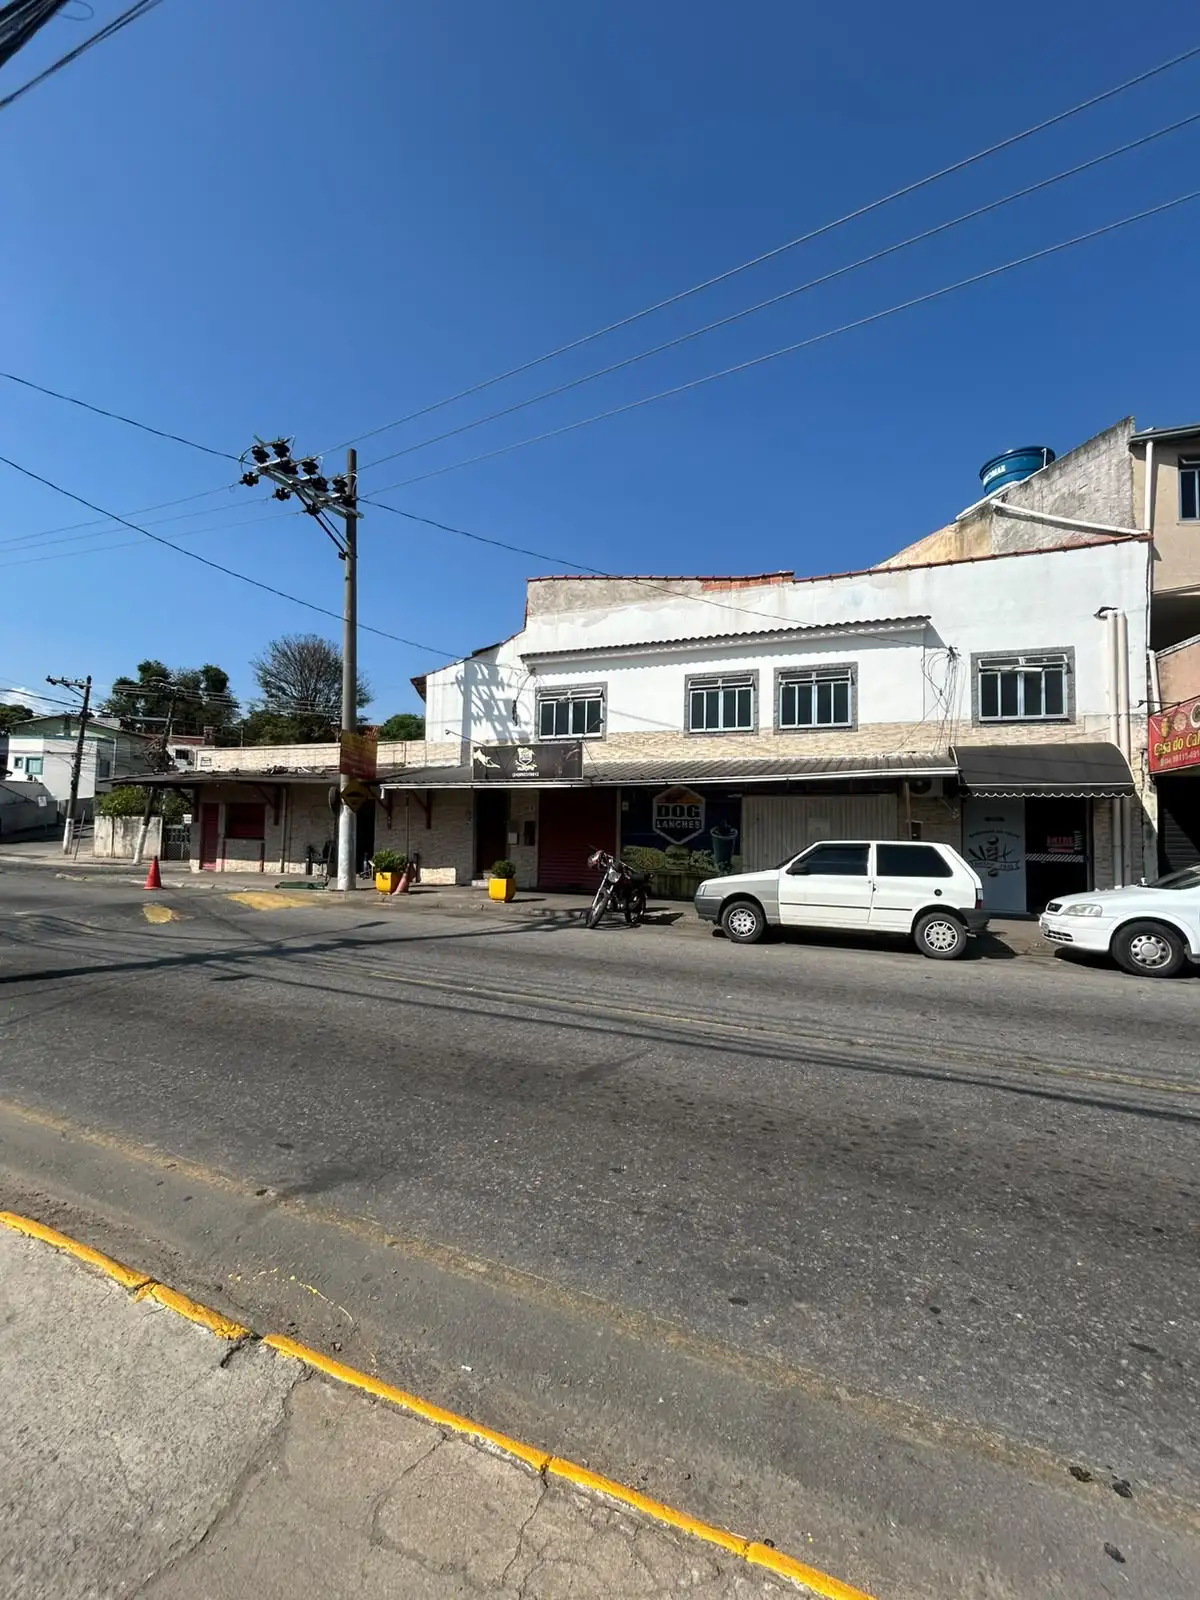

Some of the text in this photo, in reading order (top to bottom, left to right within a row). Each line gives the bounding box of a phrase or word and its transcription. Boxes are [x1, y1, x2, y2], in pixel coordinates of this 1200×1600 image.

[1173, 737, 1184, 751] do
[656, 804, 701, 818] DOG
[656, 820, 701, 829] LANCHES
